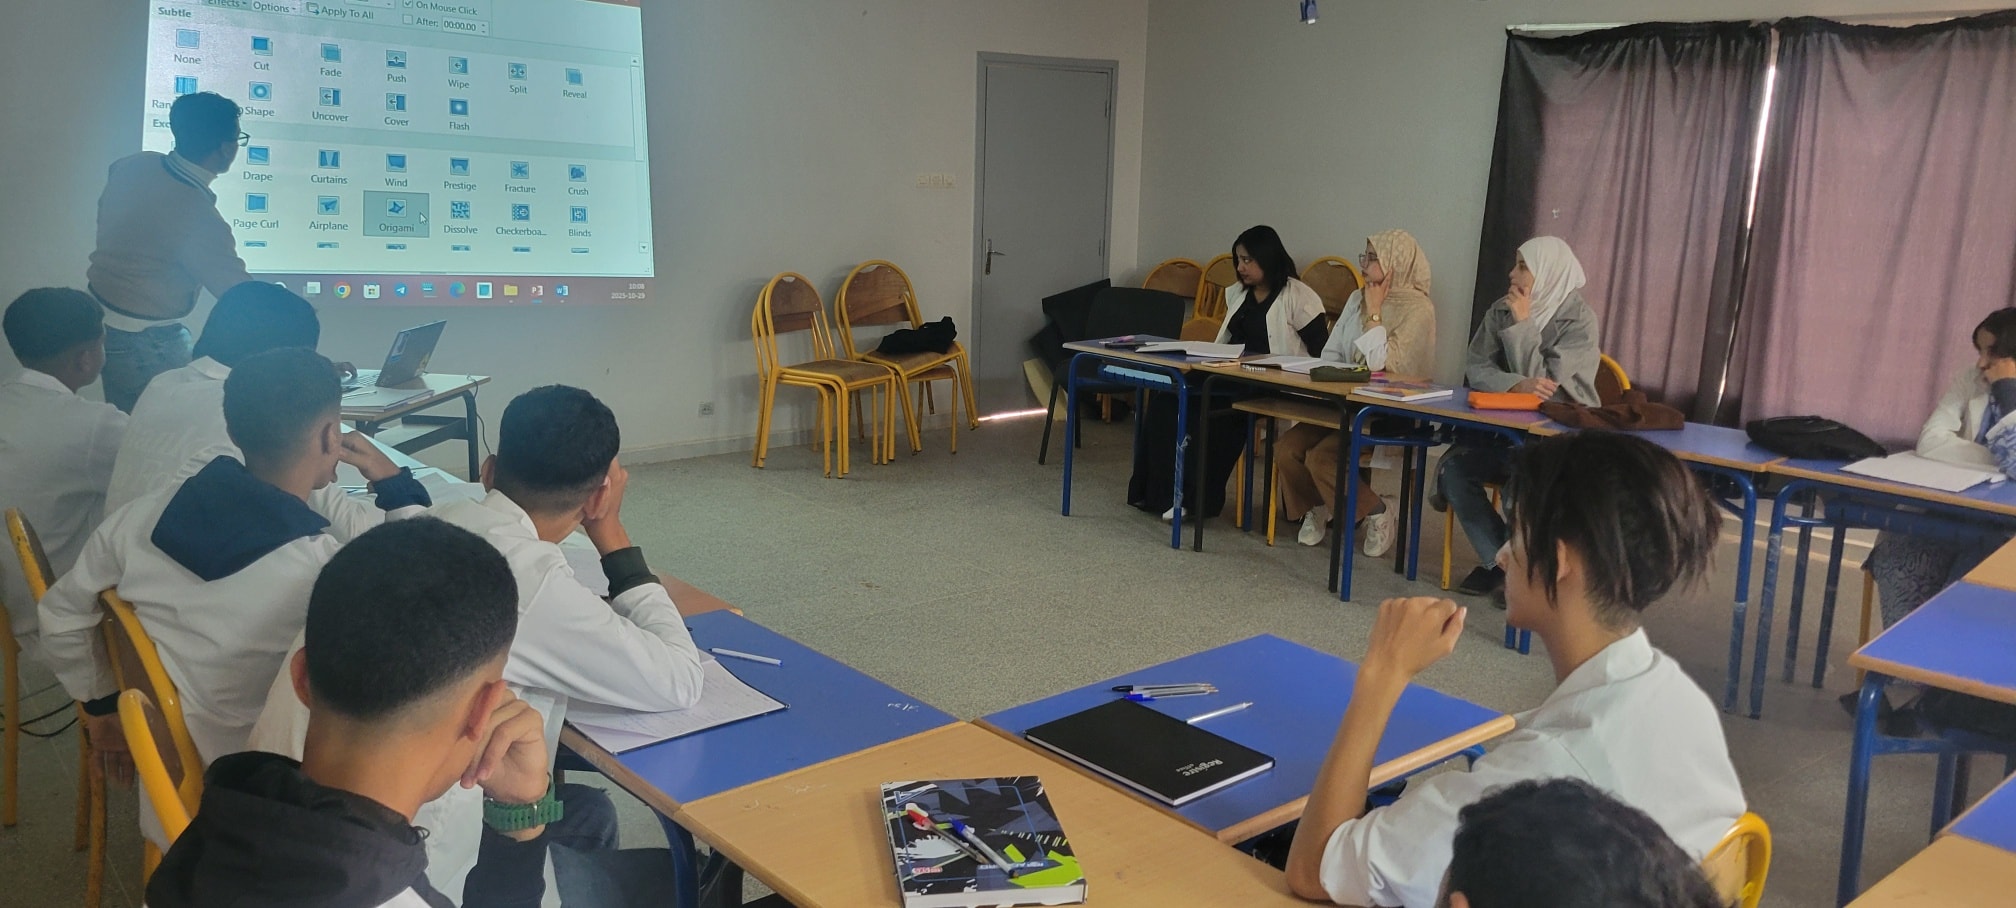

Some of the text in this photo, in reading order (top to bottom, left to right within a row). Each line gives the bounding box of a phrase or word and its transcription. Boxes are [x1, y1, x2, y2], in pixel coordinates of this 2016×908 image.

[158, 6, 192, 18] Subtle
[253, 2, 290, 13] Options
[416, 0, 478, 16] On Mouse Click
[321, 6, 374, 20] Apply To All
[416, 17, 439, 27] After:
[174, 54, 201, 65] None
[253, 61, 270, 71] Cut
[320, 67, 342, 77] Fade
[387, 74, 407, 83] Push
[448, 79, 470, 89] Wipe
[509, 84, 527, 95] Split
[562, 89, 587, 99] Reveal
[152, 99, 171, 109] Ran
[245, 106, 275, 117] Shape
[312, 111, 349, 122] Uncover
[384, 116, 409, 126] Cover
[449, 121, 470, 131] Flash
[243, 171, 273, 183] Drape
[311, 174, 348, 185] Curtains
[384, 178, 408, 187] Wind
[443, 181, 477, 191] Prestige
[504, 184, 536, 194] Fracture
[568, 187, 589, 196] Crush
[233, 218, 279, 230] Page Curl
[309, 221, 348, 232] Airplane
[379, 223, 415, 233] Origami
[443, 225, 478, 235] Dissolve
[568, 229, 592, 237] Blinds
[1183, 758, 1224, 777] Registre
